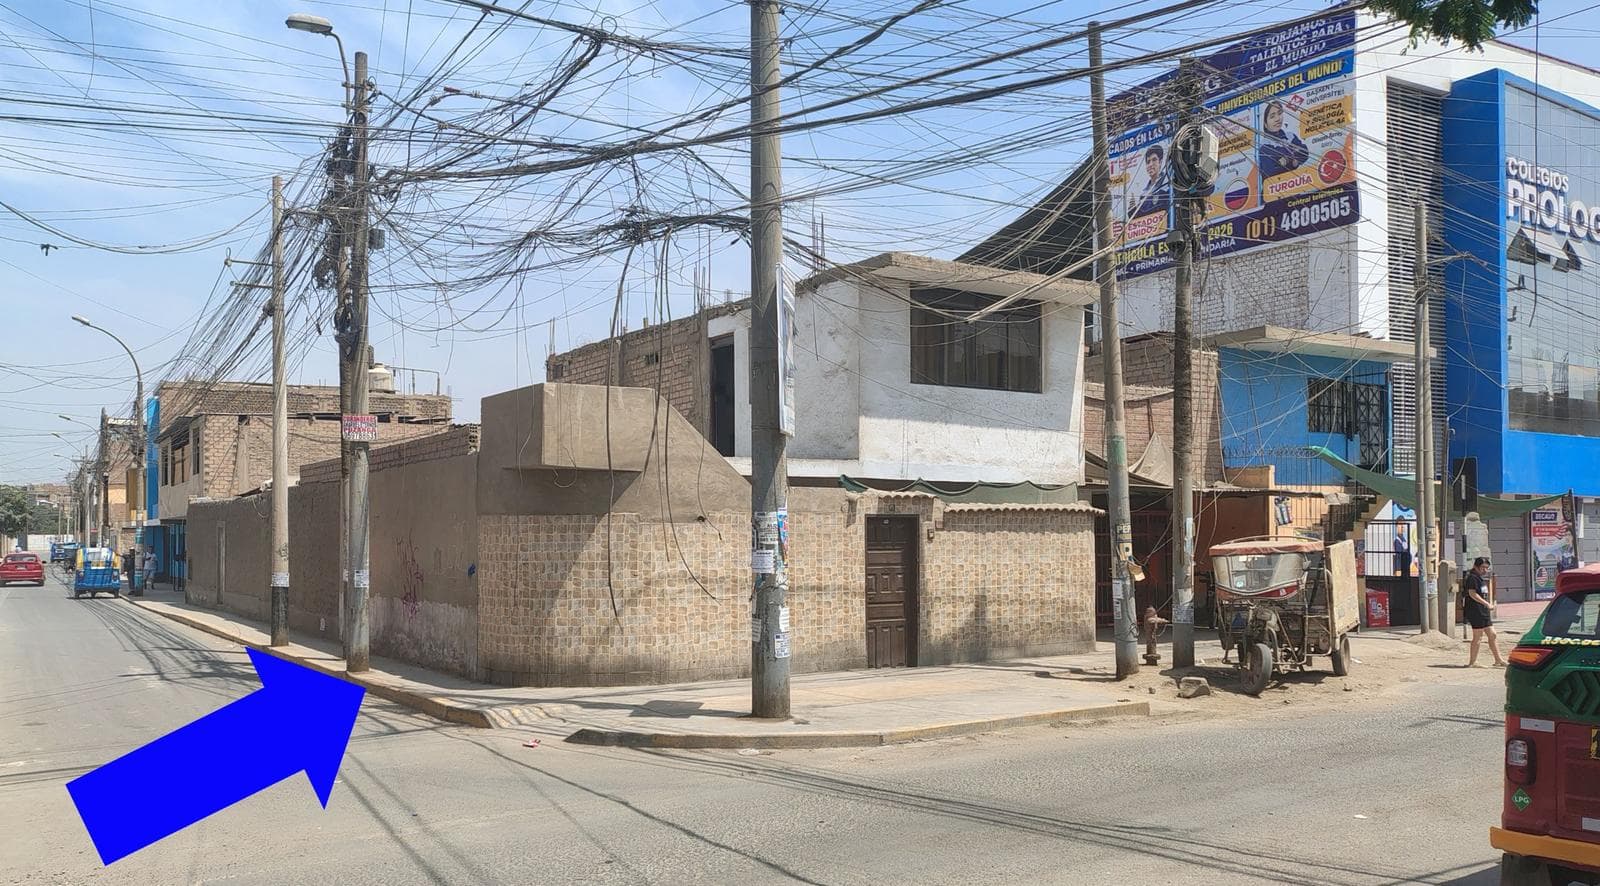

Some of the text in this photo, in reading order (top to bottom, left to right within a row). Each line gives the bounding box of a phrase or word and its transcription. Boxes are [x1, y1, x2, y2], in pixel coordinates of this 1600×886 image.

[1249, 22, 1343, 64] TALENTOS PARA
[1265, 18, 1327, 47] FORJAMOS
[1264, 41, 1326, 73] EL MUNDO
[1217, 81, 1286, 115] UNIVERSIDADES
[1288, 75, 1306, 91] DEL
[1108, 138, 1135, 155] CADOS
[1136, 133, 1147, 146] EN
[1148, 127, 1163, 141] LAS
[1268, 174, 1313, 194] TURQUÍA
[1506, 157, 1569, 193] COLEGIOS
[1287, 197, 1311, 208] Central
[1127, 214, 1164, 231] ESTADOS
[1208, 222, 1233, 240] 2026
[1246, 196, 1351, 240] (01) 4800505
[1127, 225, 1158, 240] UNIDOS
[1514, 796, 1530, 804] LPG
